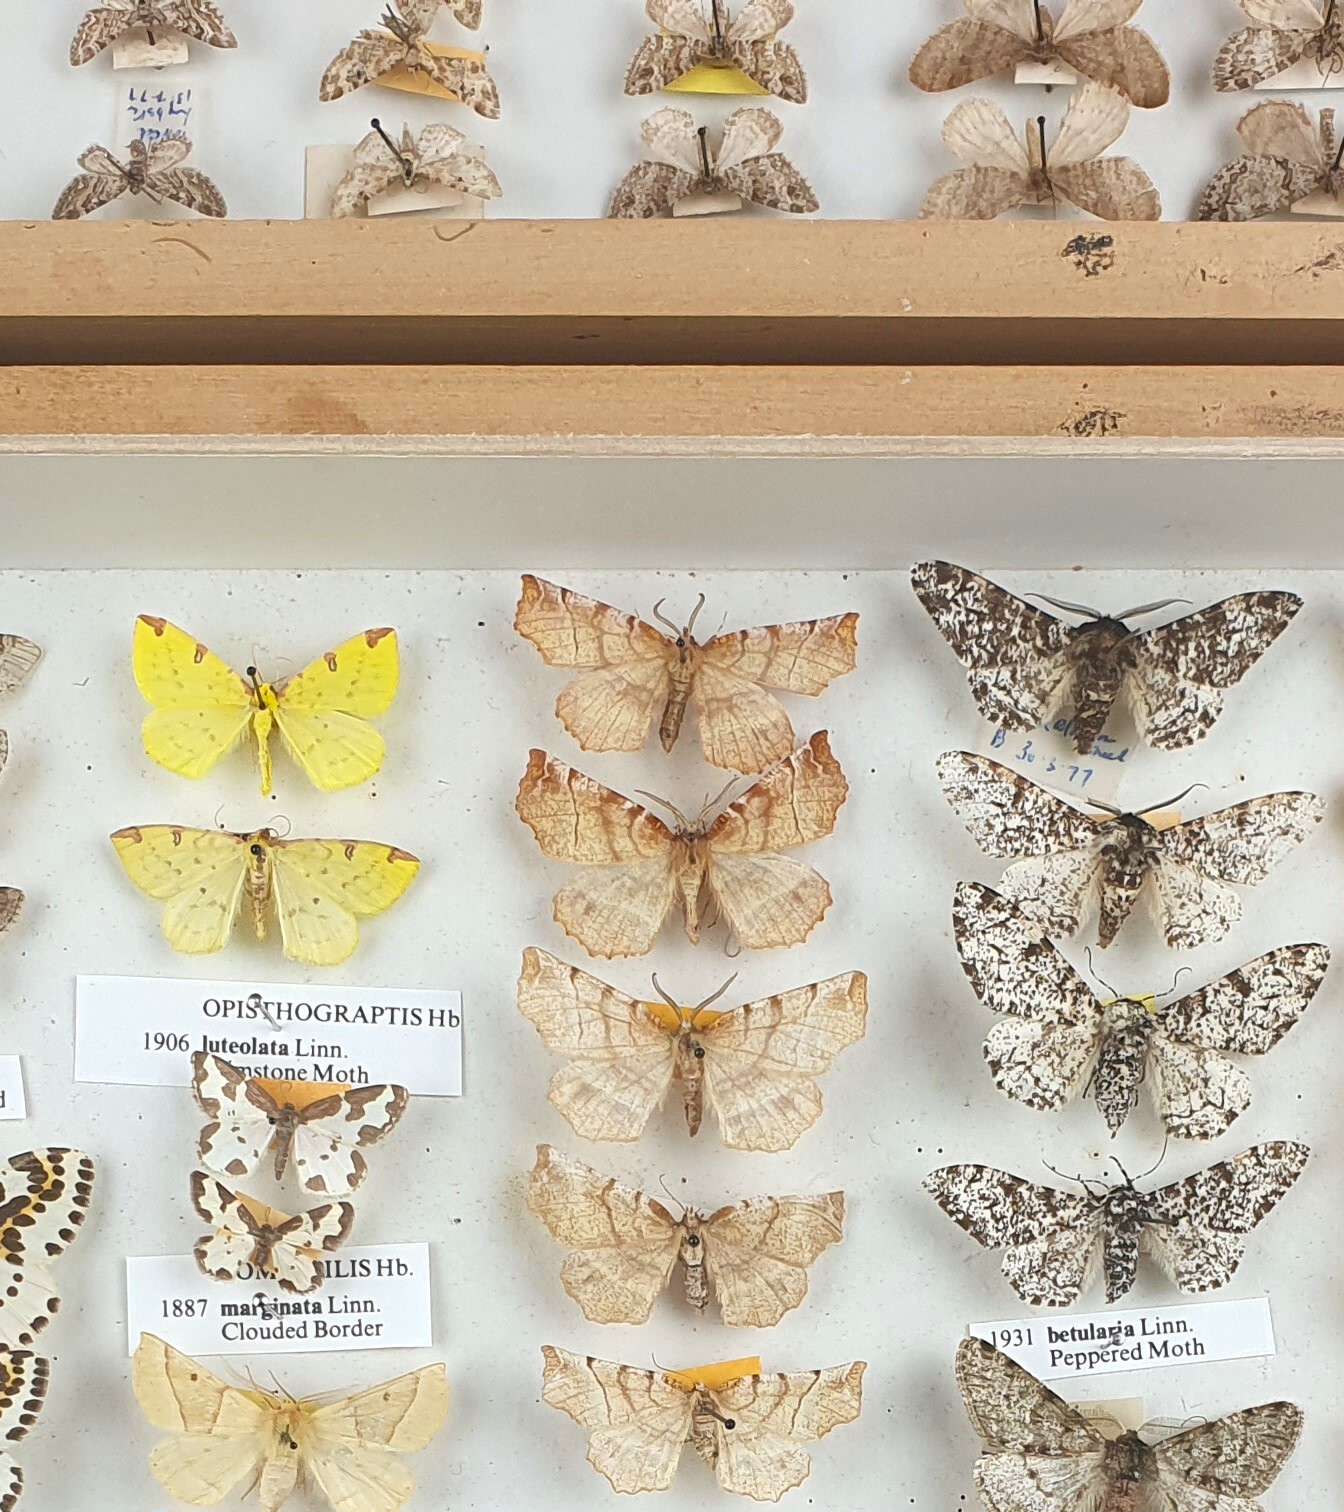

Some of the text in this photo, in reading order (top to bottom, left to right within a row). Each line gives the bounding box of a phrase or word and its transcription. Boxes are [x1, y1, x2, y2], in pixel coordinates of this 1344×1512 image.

[203, 998, 423, 1027] OPISTHOGRAPTIS
[143, 1032, 349, 1059] 1906 luteolata Linn.
[313, 1065, 369, 1085] Moth
[376, 1257, 414, 1277] Hb.
[161, 1298, 208, 1318] 1887
[328, 1295, 380, 1315] Linn.
[221, 1320, 384, 1341] Clouded Border
[990, 1317, 1194, 1348] 1931 betularia Linn.
[1049, 1338, 1205, 1371] Peppered Moth
